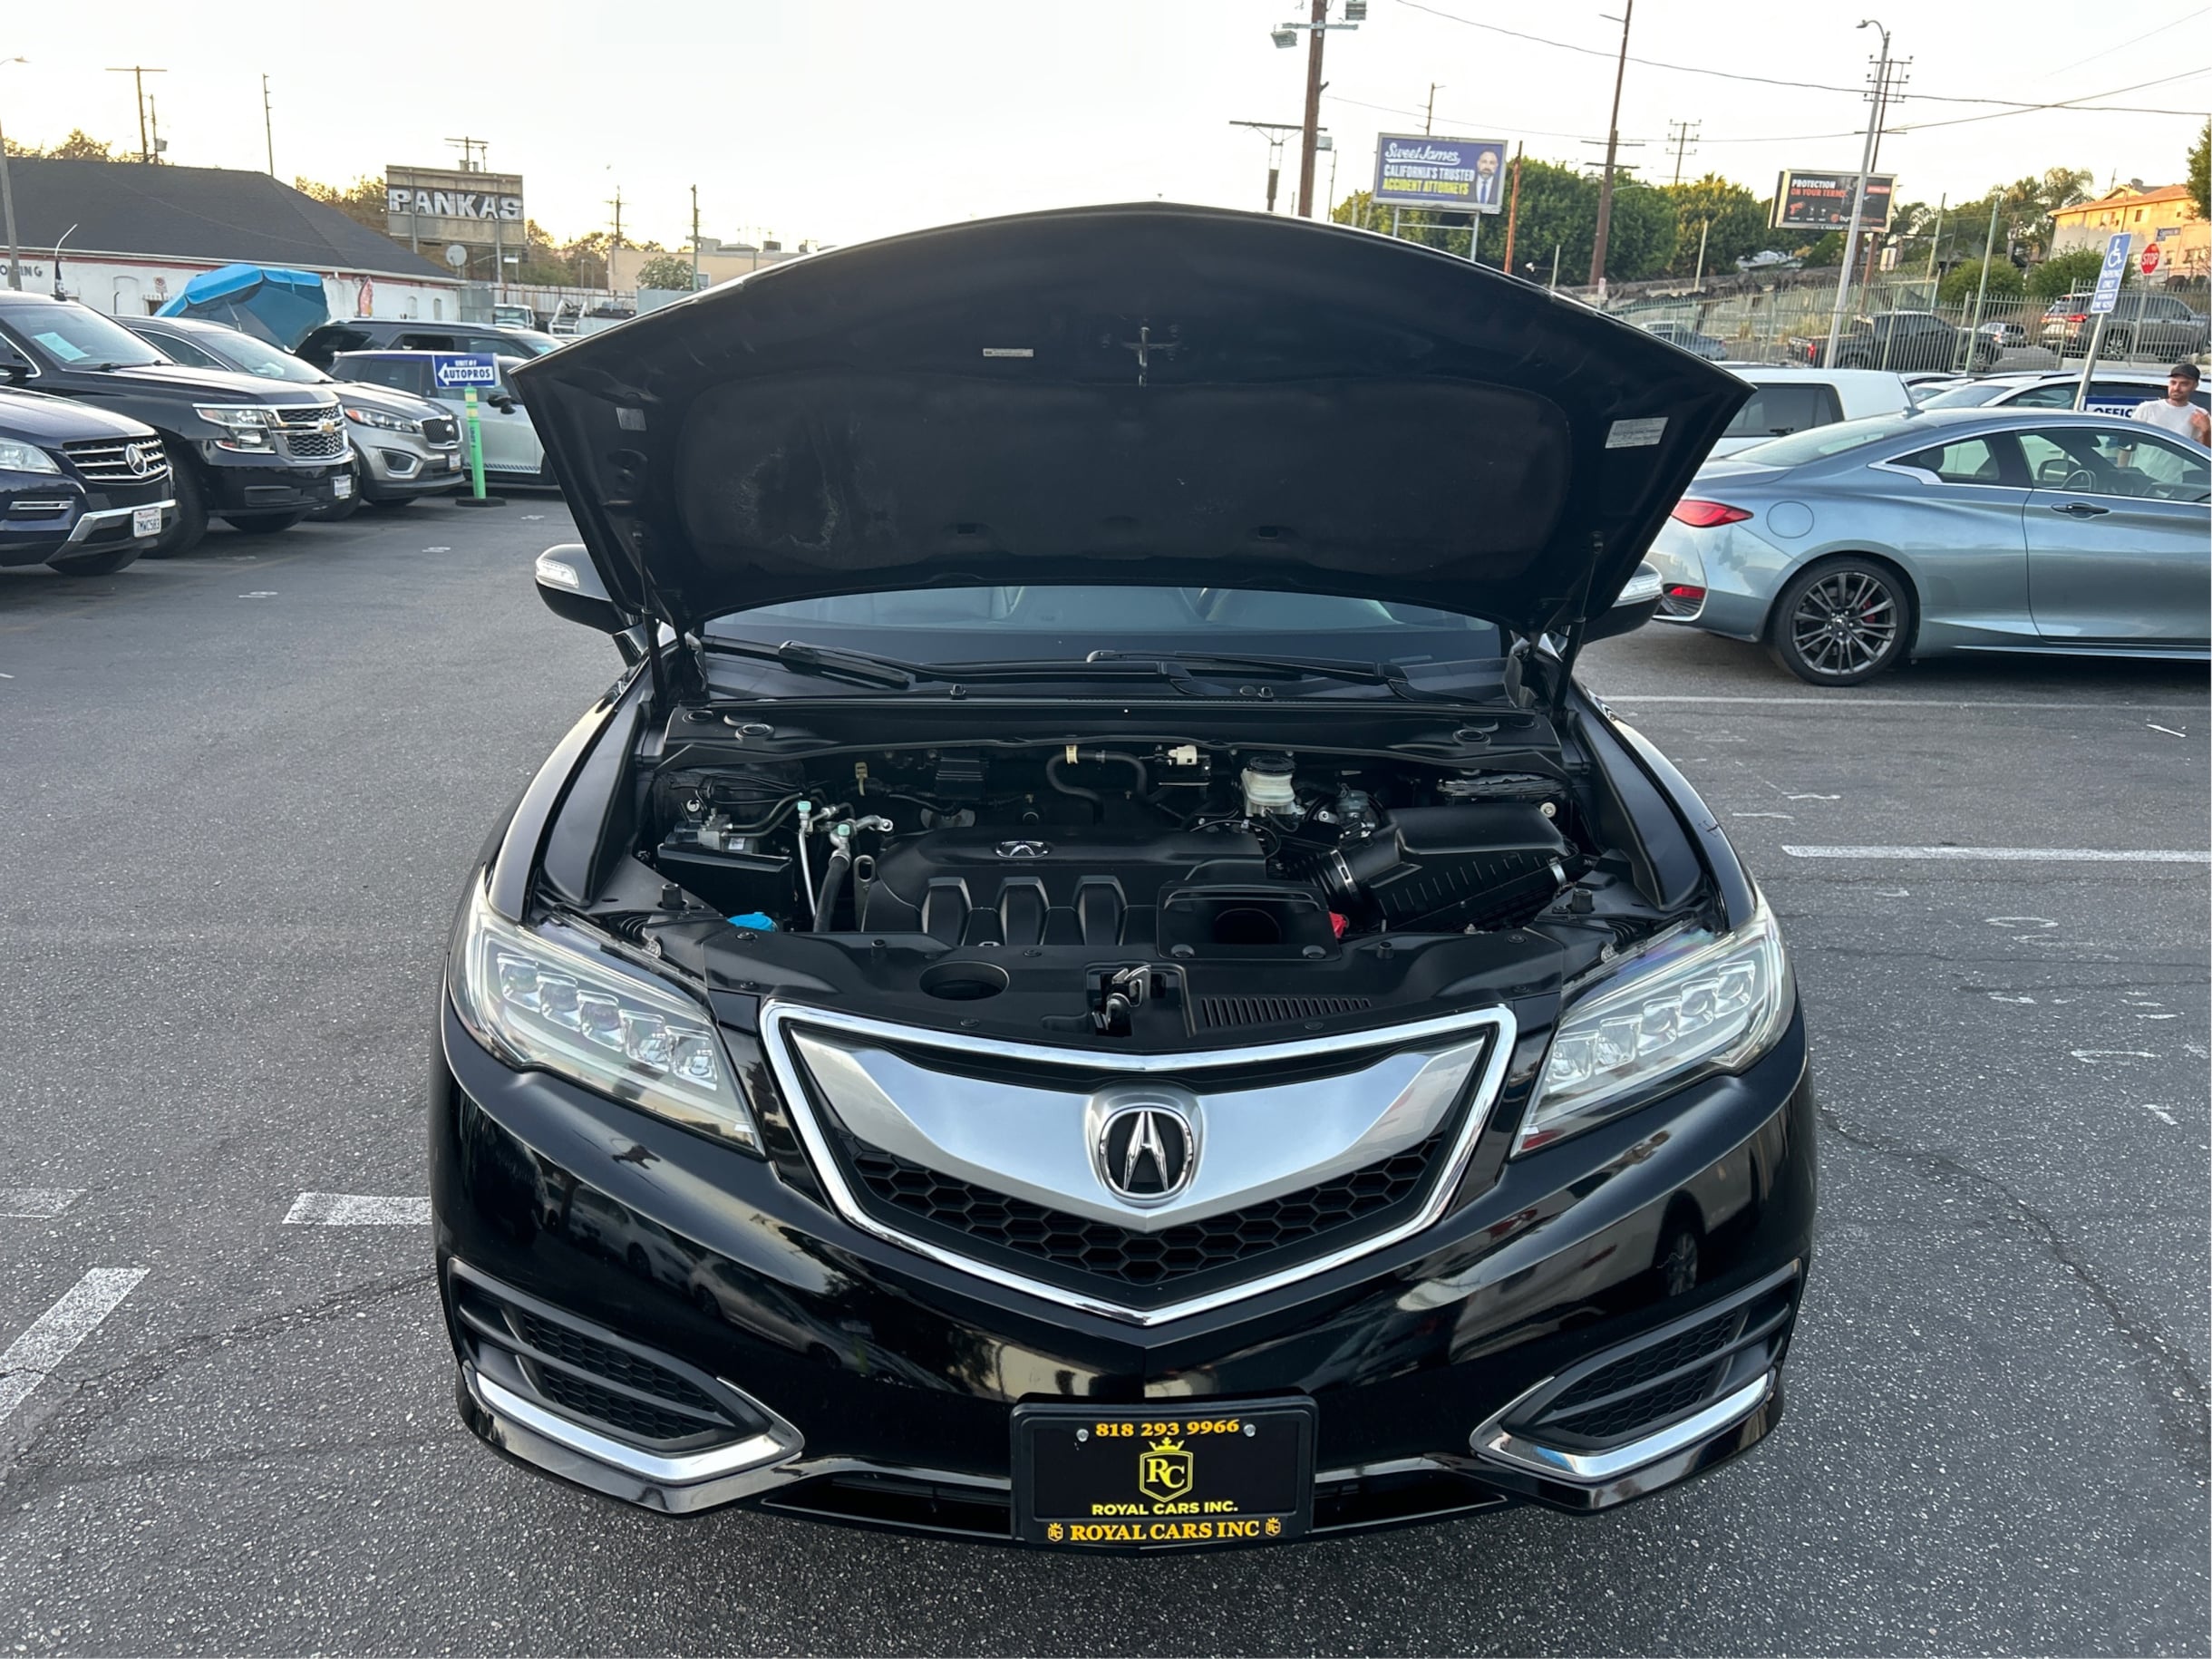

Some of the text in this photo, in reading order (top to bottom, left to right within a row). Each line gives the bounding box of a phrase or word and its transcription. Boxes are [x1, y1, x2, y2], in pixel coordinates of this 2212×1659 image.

[1384, 141, 1460, 163] Sweet James
[1383, 164, 1475, 182] CALIFORNIA'S TRUSTED
[1382, 178, 1470, 195] ACCIDENT ATTORNEYS
[1791, 179, 1836, 189] PROTECTION
[1803, 189, 1821, 197] YOUR
[388, 189, 523, 220] PANKAS
[2141, 253, 2159, 266] STOP
[443, 368, 490, 379] AUTOPROS
[2093, 407, 2134, 418] OFFIC
[1095, 1419, 1239, 1437] 818 293 9966
[1091, 1500, 1238, 1516] ROYAL CARS INC.
[1070, 1524, 1147, 1541] ROYAL
[1150, 1522, 1213, 1540] CARS
[1217, 1519, 1260, 1538] INC
